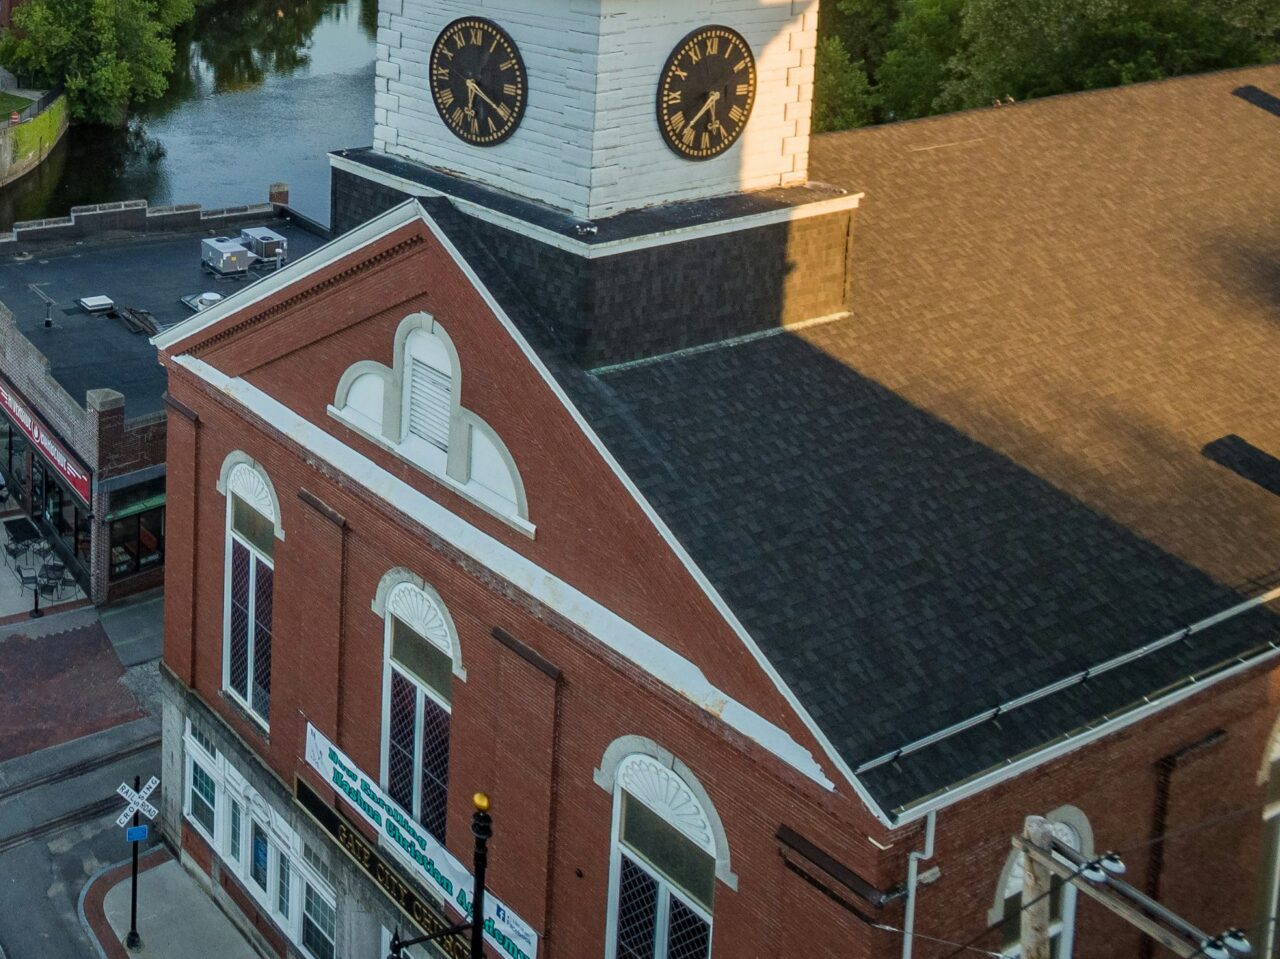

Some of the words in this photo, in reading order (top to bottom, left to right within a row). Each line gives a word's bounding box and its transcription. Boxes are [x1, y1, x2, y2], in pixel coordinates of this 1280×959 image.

[453, 31, 465, 49] XI
[470, 28, 483, 46] XII
[442, 46, 454, 60] X
[489, 40, 498, 53] I
[688, 45, 702, 64] XI
[706, 38, 719, 56] XII
[724, 43, 733, 58] I
[438, 67, 449, 80] IX
[499, 60, 512, 71] II
[675, 67, 688, 80] X
[733, 60, 746, 73] II
[503, 84, 516, 95] III
[668, 90, 681, 105] IX
[736, 84, 748, 95] III
[470, 118, 479, 135] VI
[488, 116, 497, 133] V
[720, 125, 728, 140] V
[701, 132, 710, 149] VI
[119, 779, 158, 825] CROSSING
[328, 747, 358, 780] Now
[361, 778, 428, 851] Enrolling
[332, 767, 382, 826] Nashua
[386, 823, 454, 896] Christian
[456, 888, 531, 959] Acdem
[338, 824, 370, 869] GATE
[377, 865, 408, 907] CITY
[413, 901, 472, 959] CHURC
